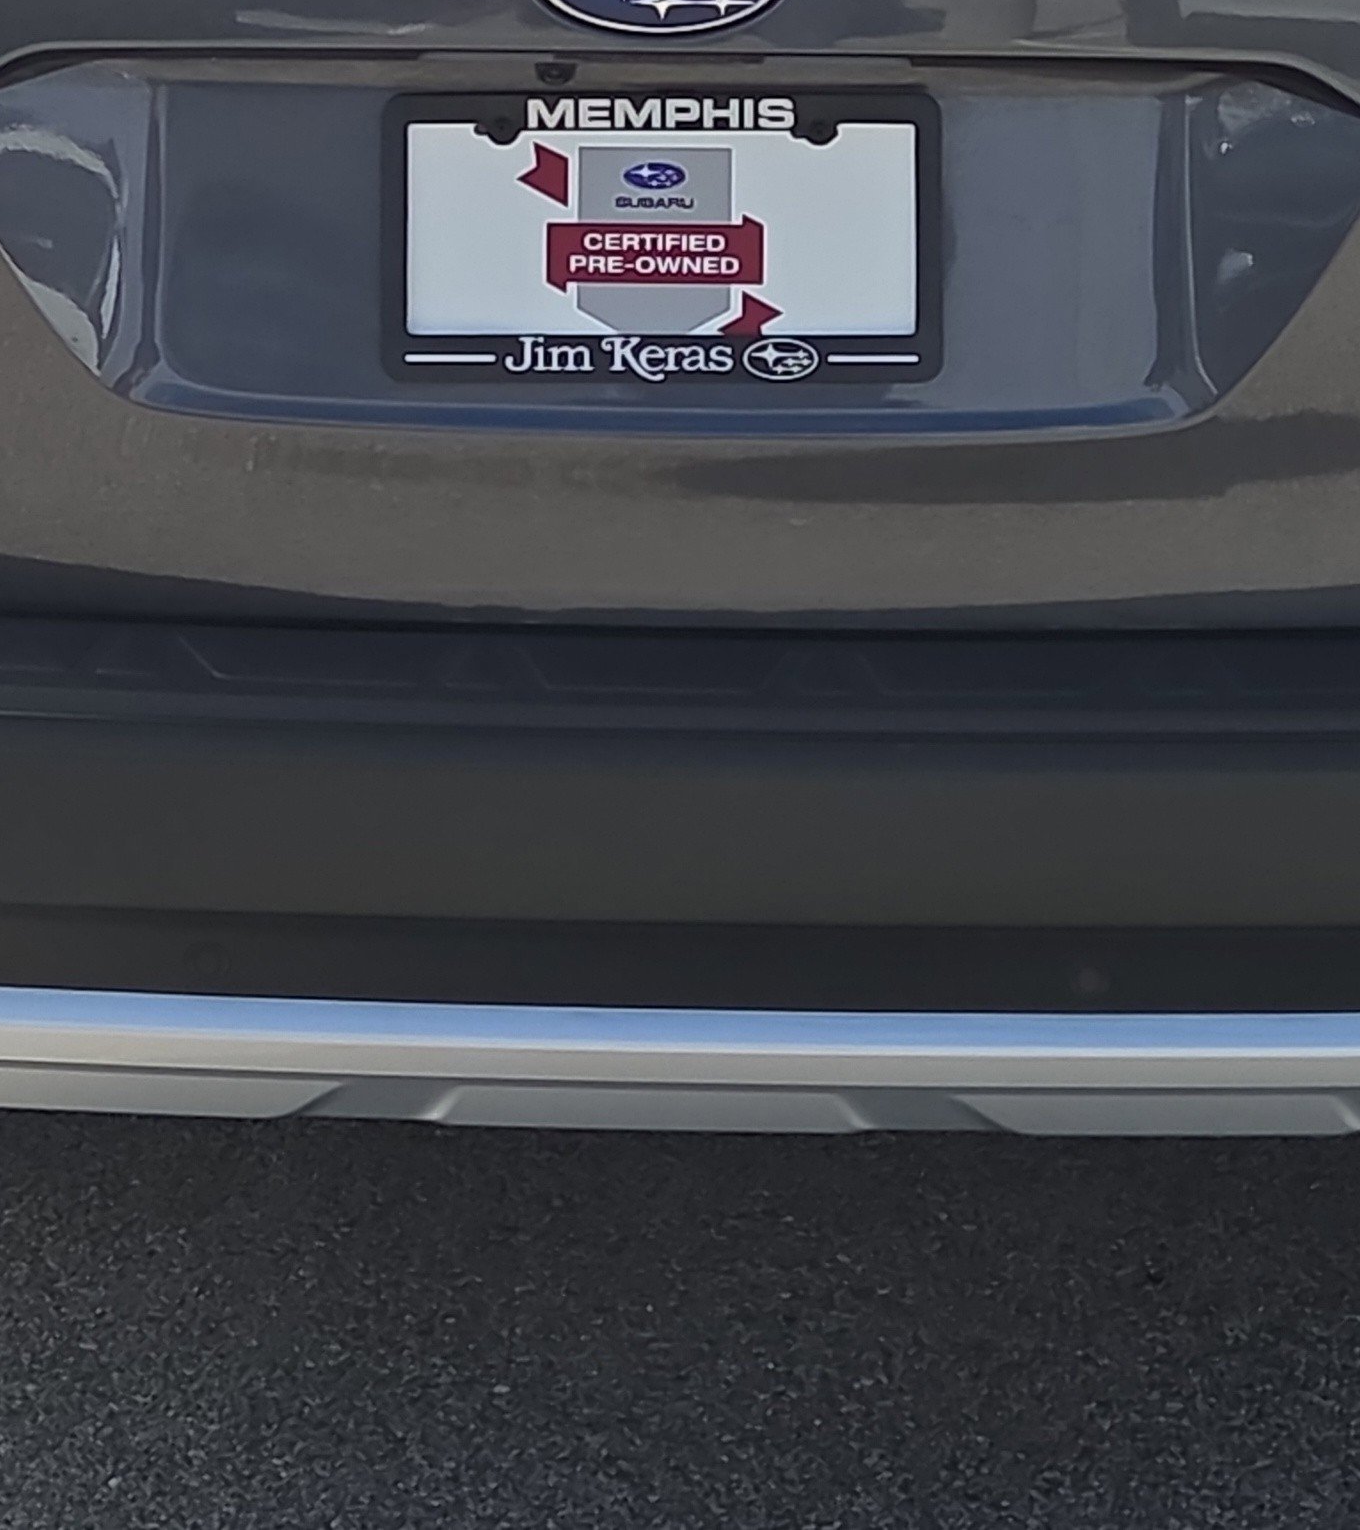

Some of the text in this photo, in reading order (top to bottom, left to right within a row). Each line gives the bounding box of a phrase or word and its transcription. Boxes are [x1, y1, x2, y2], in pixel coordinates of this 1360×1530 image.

[526, 98, 796, 130] MEMPHIS
[614, 196, 695, 210] SUBARU
[583, 232, 726, 253] CERTIFIED
[568, 254, 741, 275] PRE-OWNED
[503, 336, 735, 382] Jim Keras
